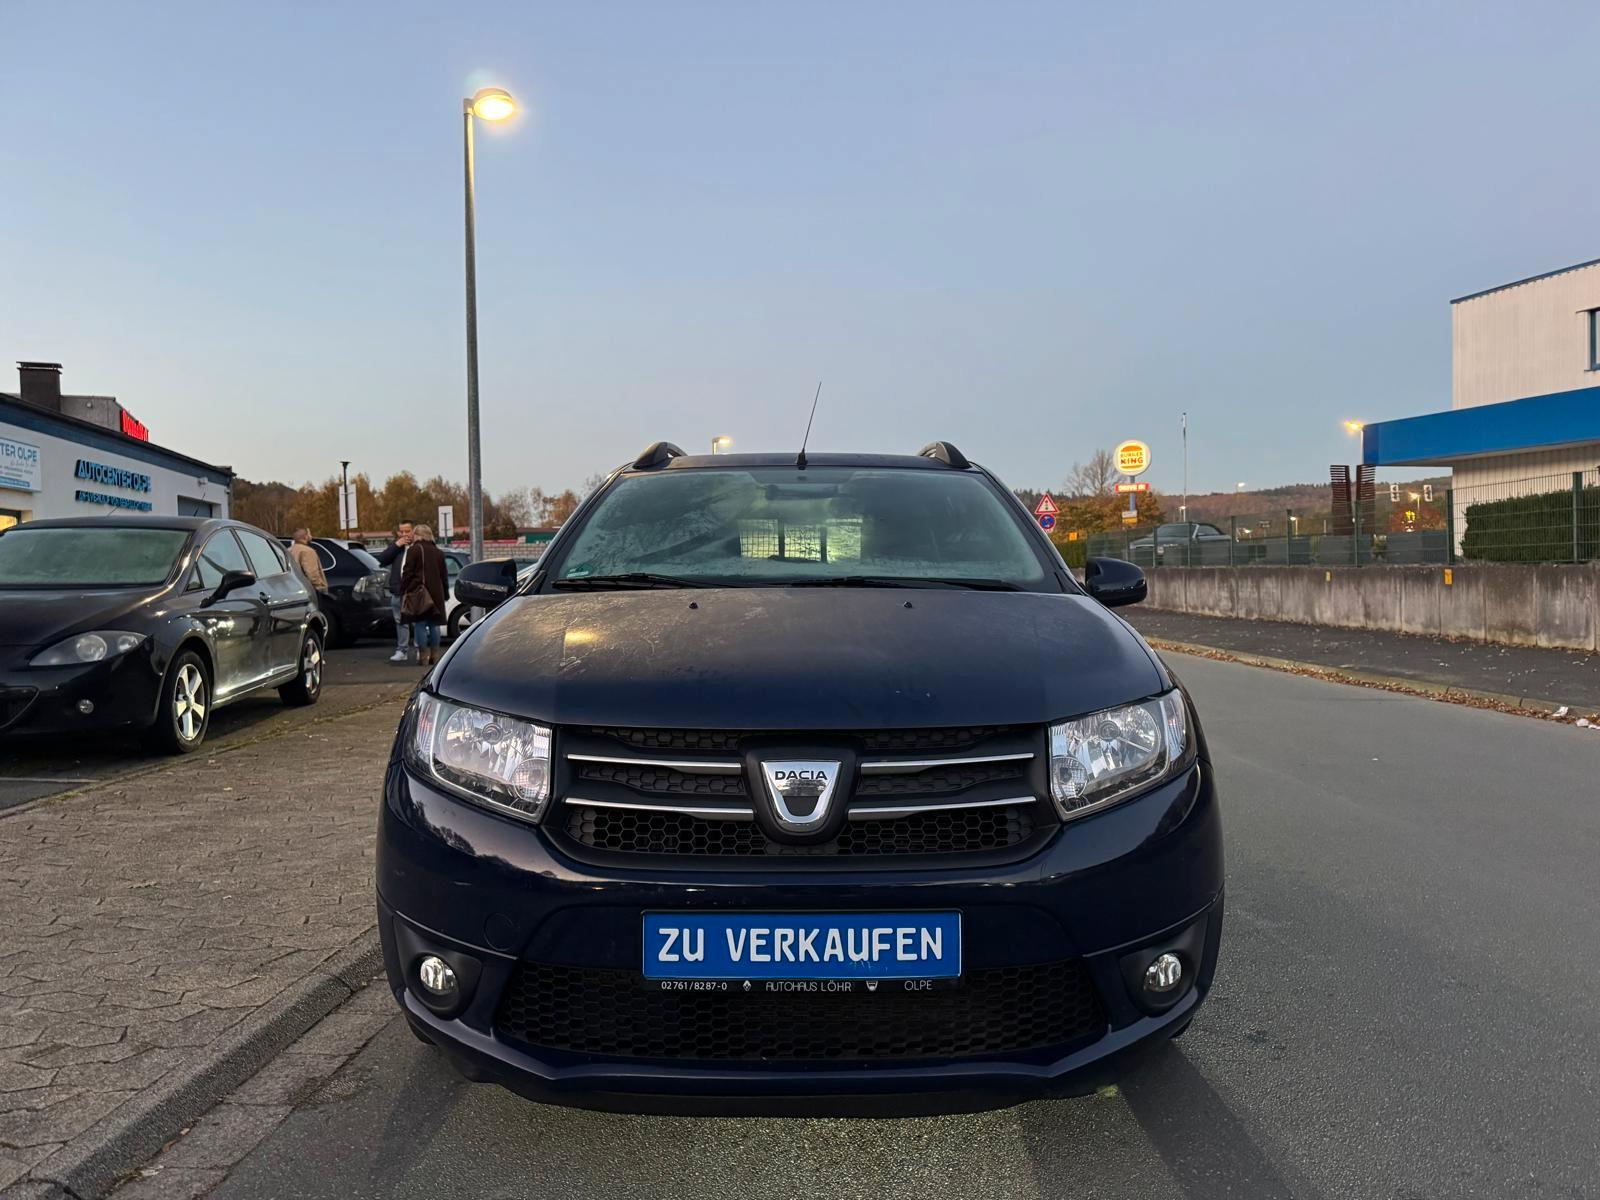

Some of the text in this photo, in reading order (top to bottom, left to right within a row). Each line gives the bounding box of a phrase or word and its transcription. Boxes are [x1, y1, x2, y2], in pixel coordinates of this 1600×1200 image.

[17, 446, 38, 462] OLPE
[1120, 456, 1144, 464] KING
[77, 460, 131, 488] AUTOCENTER
[774, 770, 828, 781] DACIA
[658, 927, 943, 962] ZU VERKAUFEN
[660, 980, 933, 992] 02761/8287-0 AUTOHAUS LÖHR OLPE
